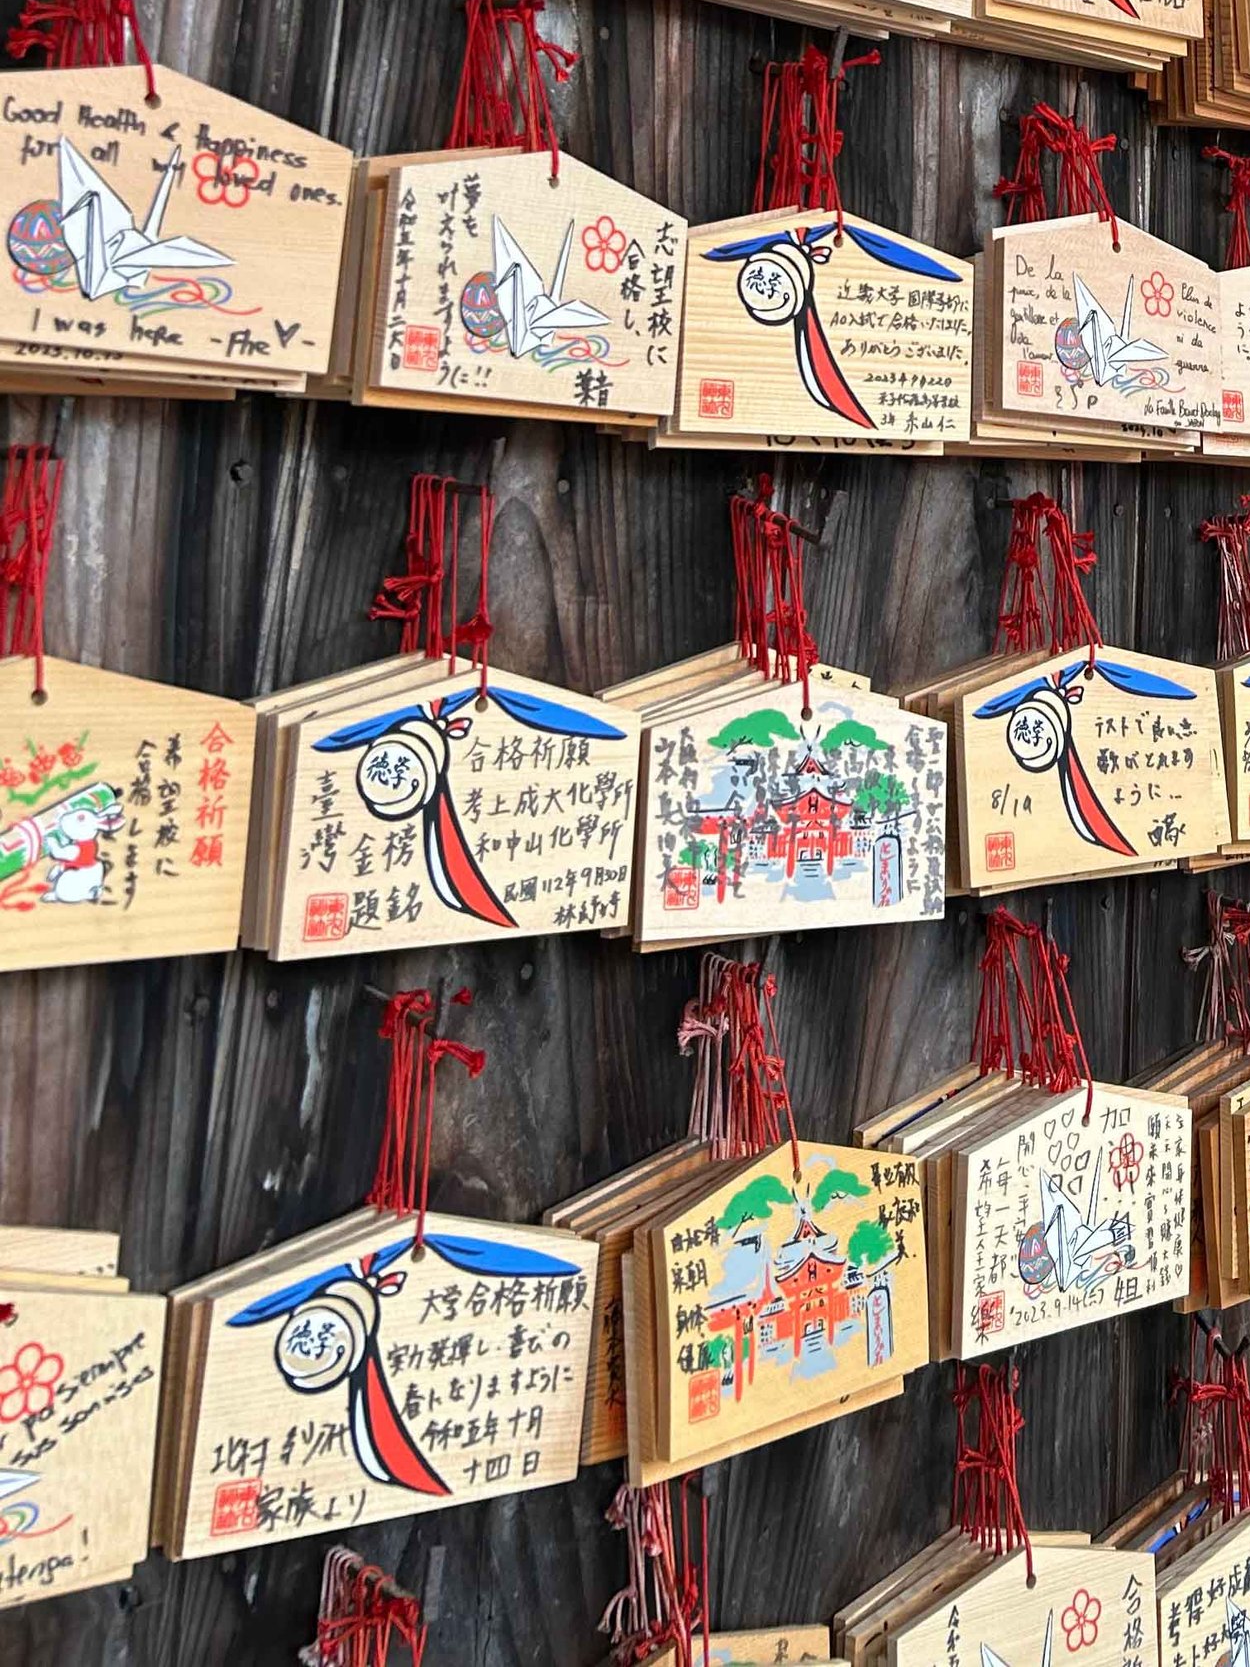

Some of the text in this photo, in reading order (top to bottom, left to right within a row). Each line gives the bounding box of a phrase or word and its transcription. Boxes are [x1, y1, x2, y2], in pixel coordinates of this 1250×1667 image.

[3, 95, 308, 170] Good Health Happiness
[90, 138, 121, 164] all
[1015, 253, 1065, 282] De la
[646, 220, 679, 366] 志望校に
[54, 312, 107, 336] was
[130, 313, 185, 347] here
[1175, 308, 1218, 335] violence
[462, 735, 591, 773] 合格祈願
[189, 721, 235, 867] 合格祈願
